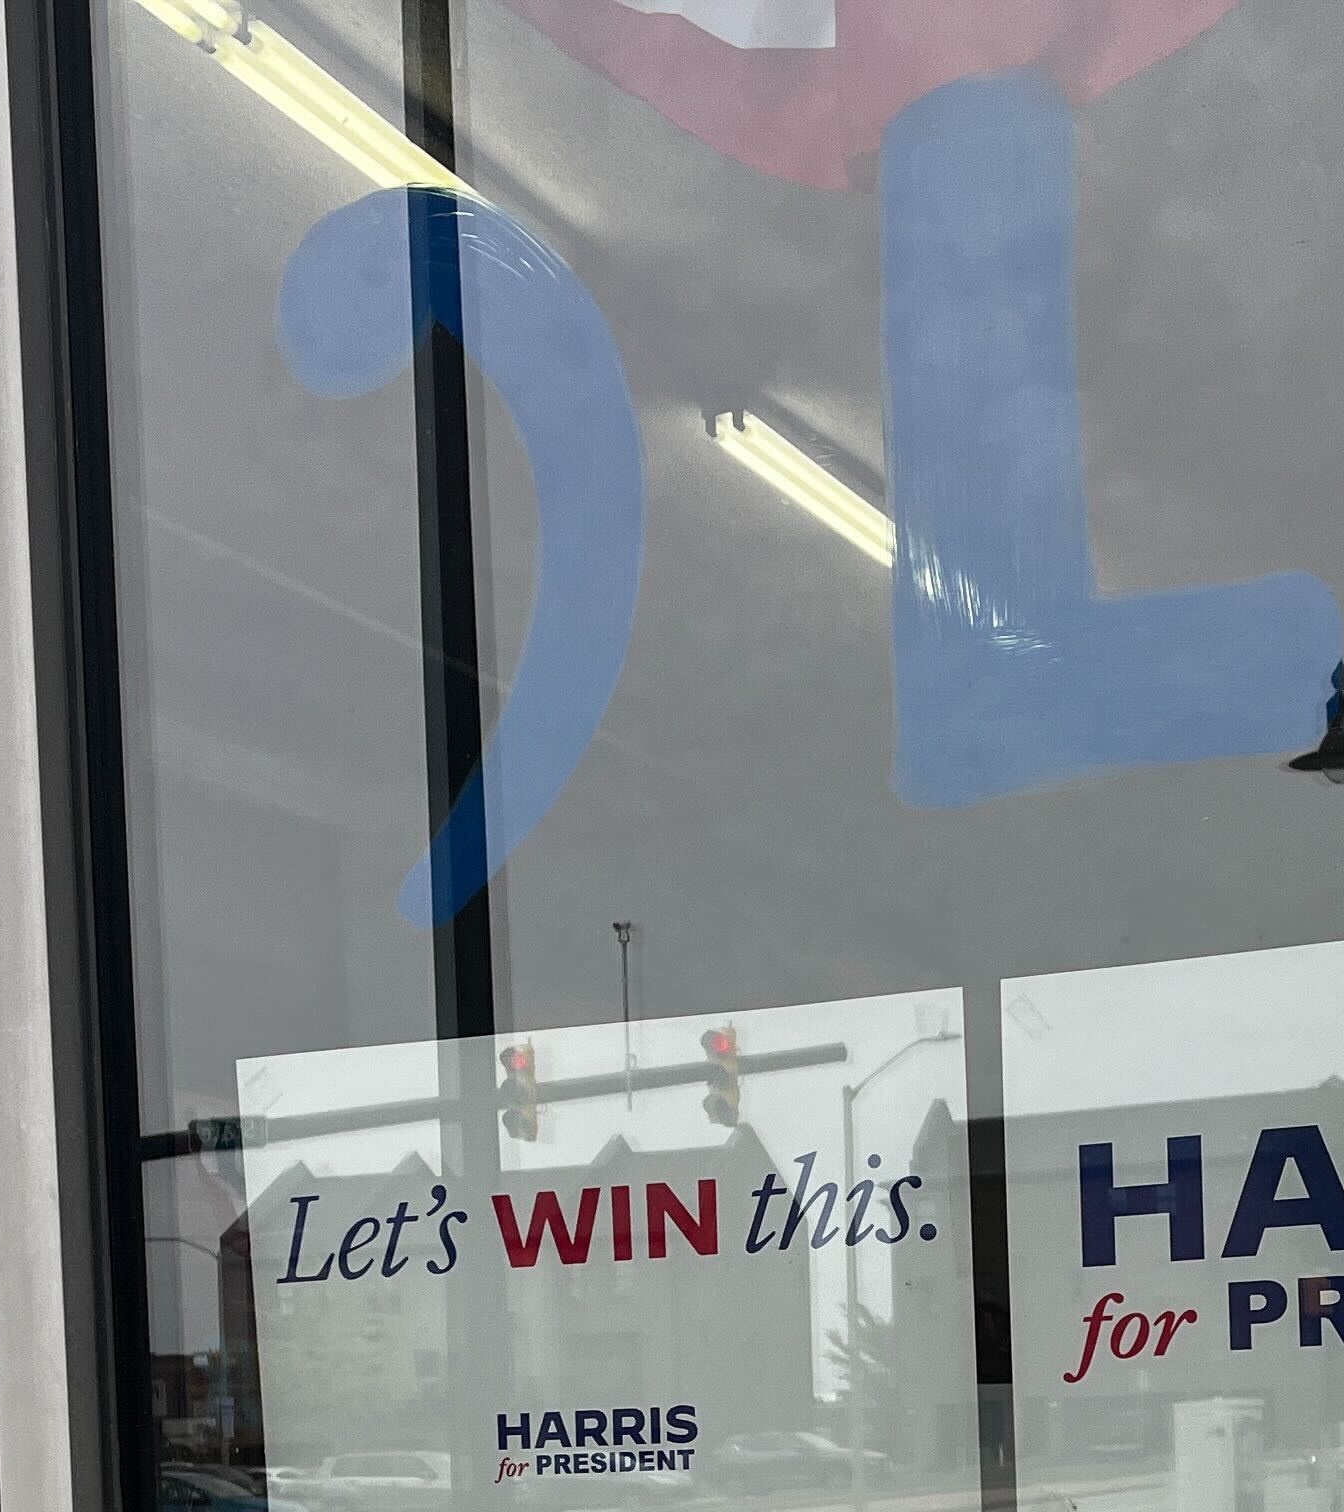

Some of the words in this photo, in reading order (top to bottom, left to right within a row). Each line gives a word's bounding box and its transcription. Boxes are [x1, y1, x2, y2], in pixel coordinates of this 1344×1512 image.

[276, 1184, 468, 1284] Let's
[491, 1178, 719, 1268] WIN
[744, 1151, 938, 1255] this.
[1063, 1293, 1197, 1383] for
[498, 1404, 699, 1450] HARRIS
[494, 1455, 530, 1484] for
[536, 1449, 696, 1476] PRESIDENT
